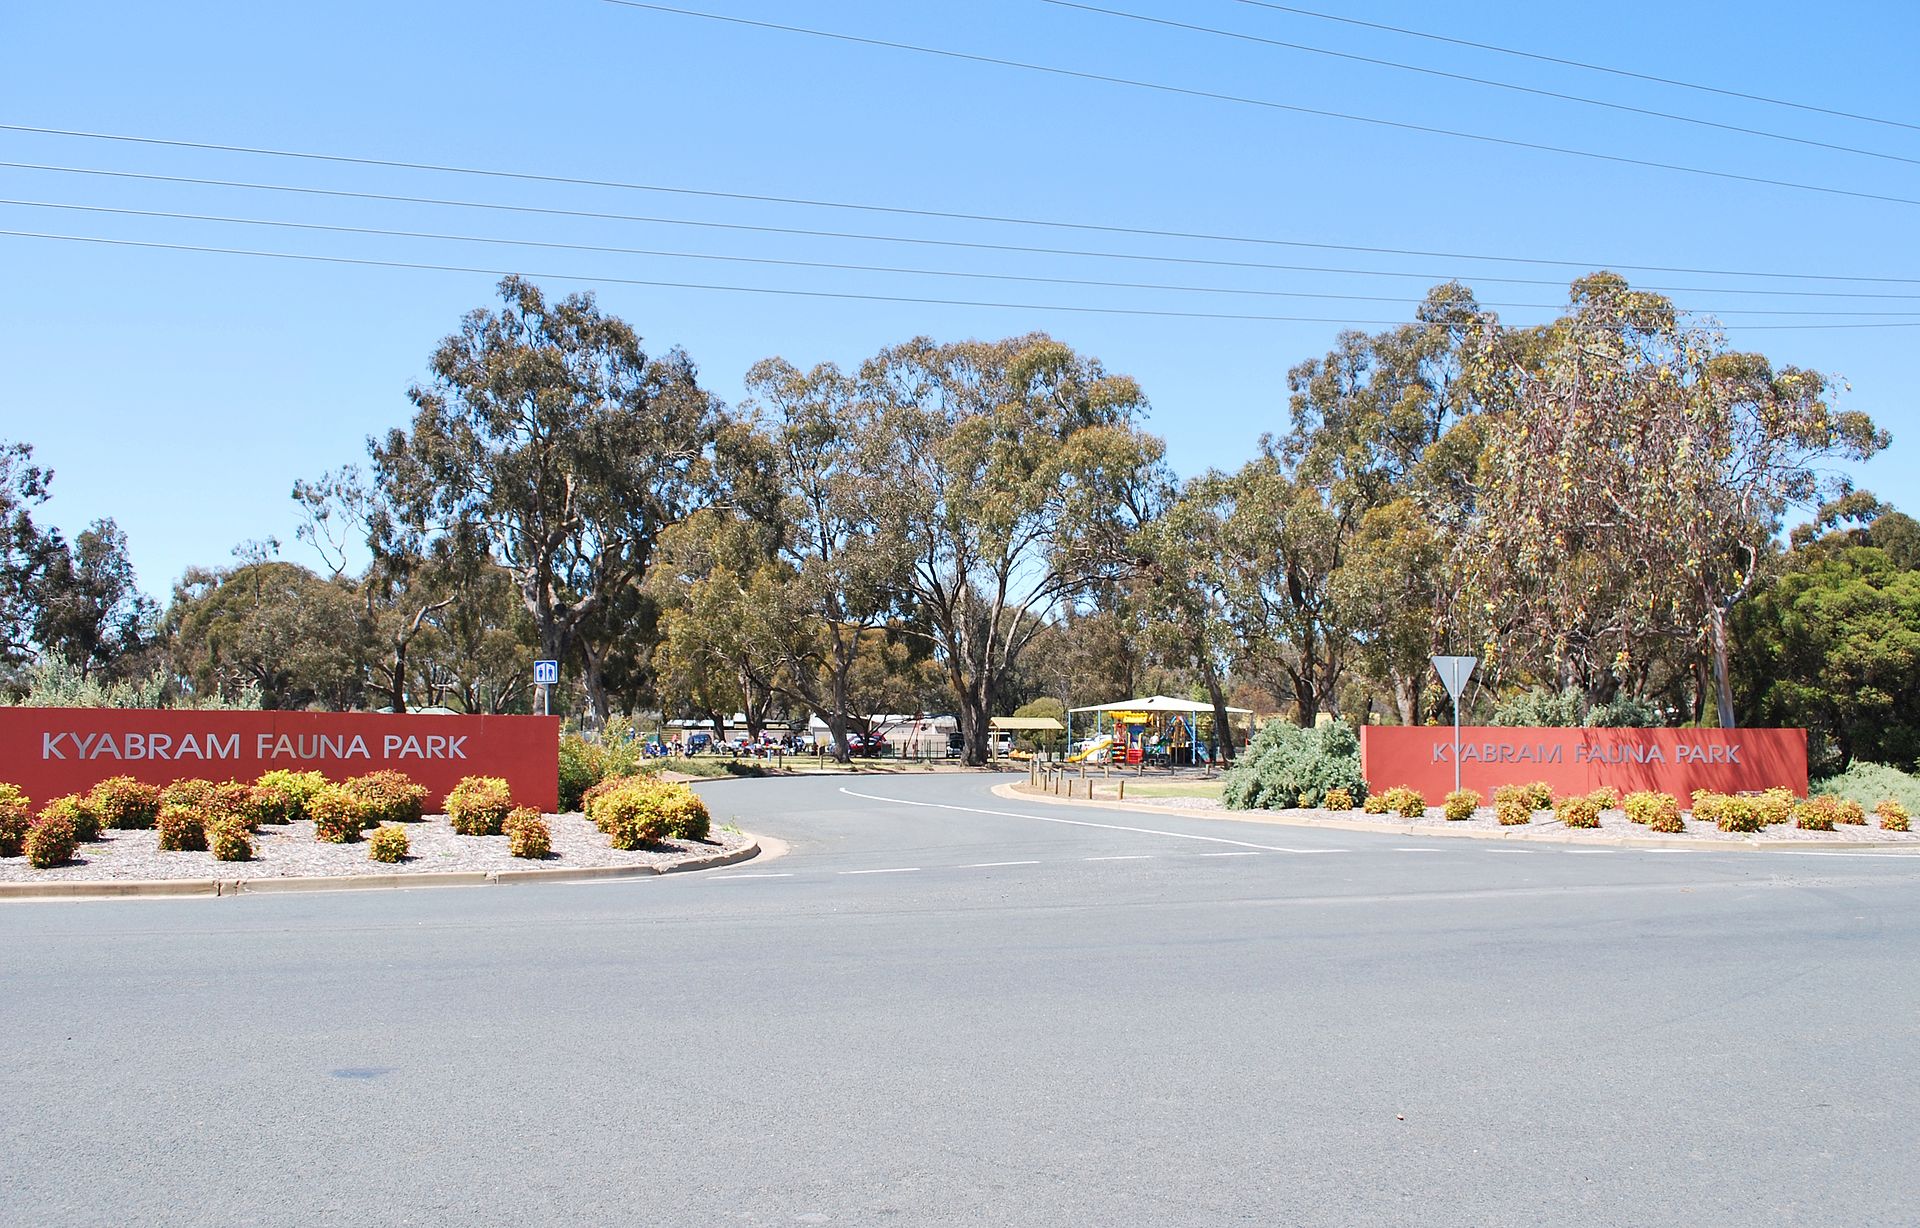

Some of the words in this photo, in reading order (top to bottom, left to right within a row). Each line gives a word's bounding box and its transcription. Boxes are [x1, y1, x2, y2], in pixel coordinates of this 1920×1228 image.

[42, 732, 240, 760] KYABRAM
[257, 733, 371, 759] FAUNA
[383, 735, 468, 759] PARK
[1433, 743, 1562, 763] KYABRAM
[1575, 744, 1666, 764] FAUNA
[1676, 744, 1741, 764] PARK
